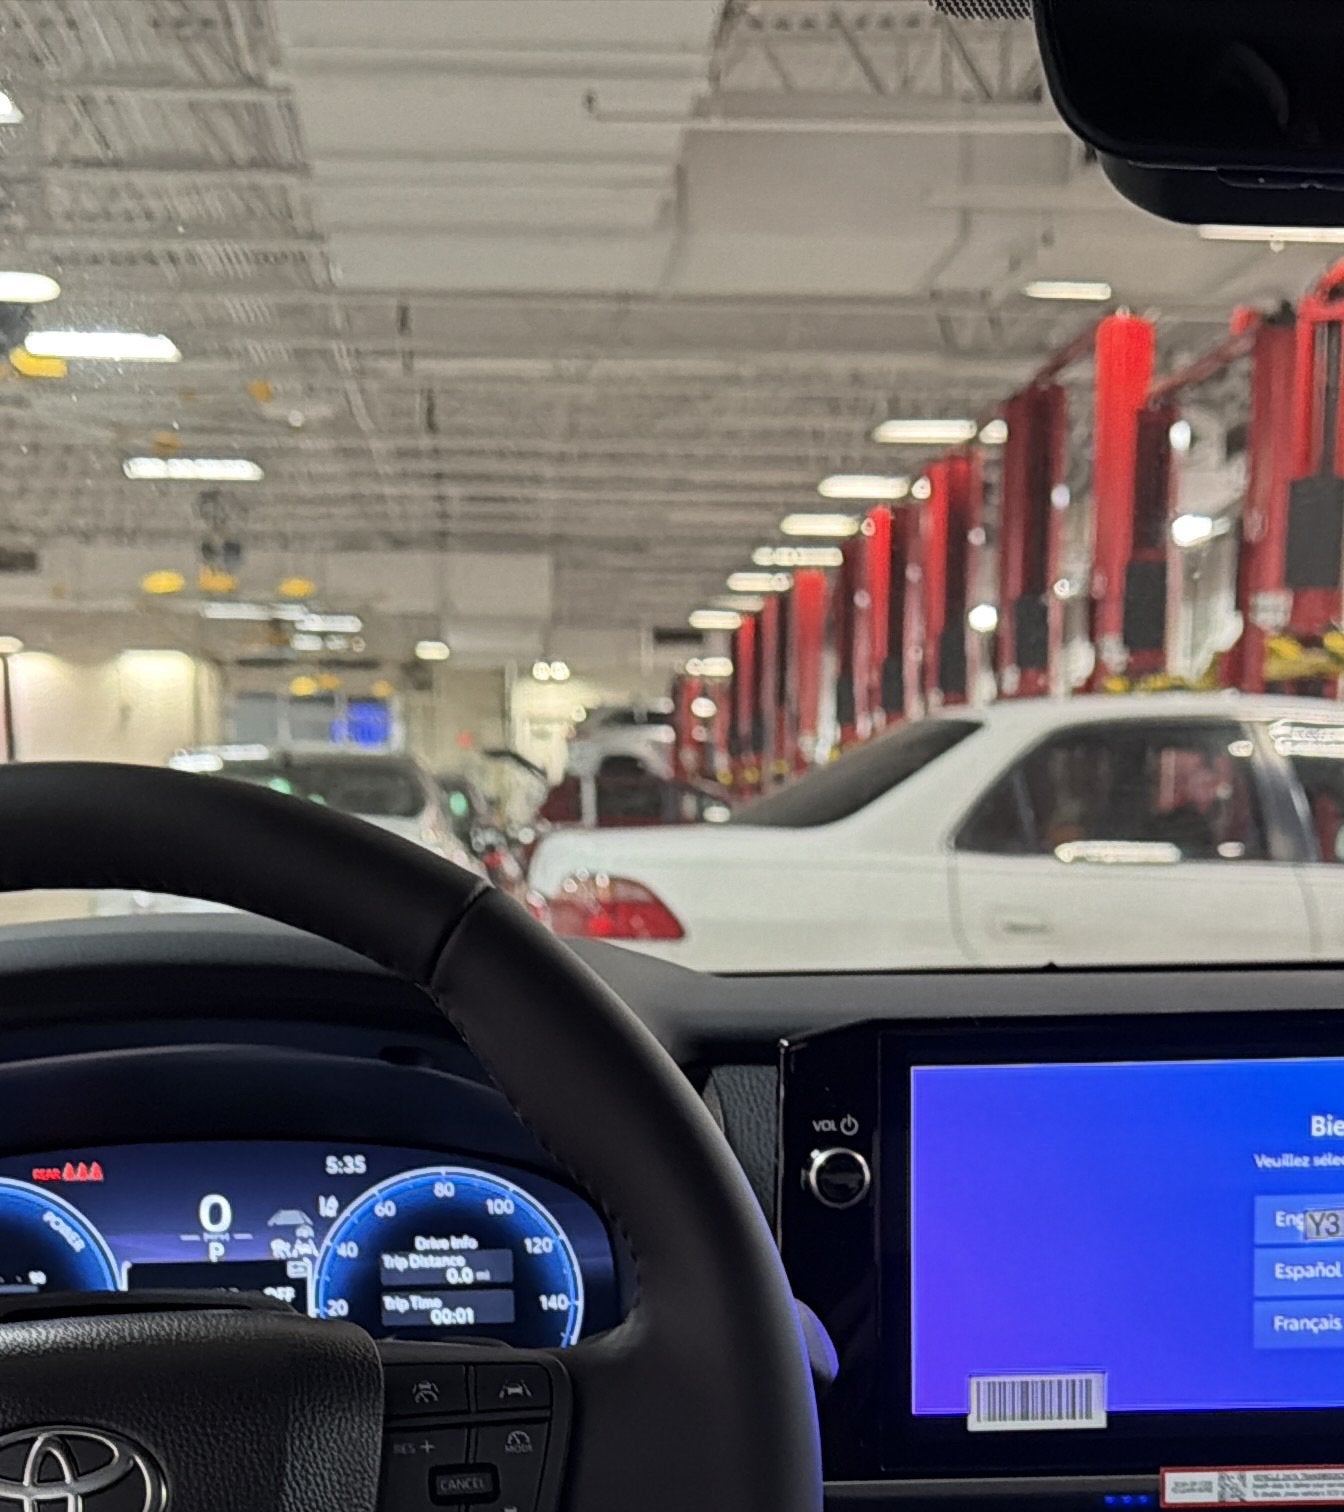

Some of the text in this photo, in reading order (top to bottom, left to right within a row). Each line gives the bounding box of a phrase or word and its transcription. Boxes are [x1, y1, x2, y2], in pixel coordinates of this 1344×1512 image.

[812, 1120, 838, 1132] VOL
[325, 1155, 367, 1175] 5:35
[1253, 1153, 1310, 1168] Veuillez
[433, 1182, 455, 1198] 80
[198, 1193, 233, 1233] 0
[374, 1200, 397, 1218] 60
[486, 1199, 515, 1216] 100
[1307, 1212, 1341, 1237] Y3
[337, 1241, 359, 1259] 40
[414, 1234, 479, 1250] Drive Info
[524, 1237, 554, 1254] 120
[208, 1241, 226, 1262] P
[382, 1252, 467, 1271] Trip Distance
[445, 1268, 491, 1284] 0.0 mi
[1274, 1261, 1343, 1281] Español
[327, 1299, 349, 1316] 20
[382, 1294, 443, 1313] Trip Time
[538, 1294, 569, 1311] 140
[430, 1307, 475, 1325] 00:01
[1273, 1314, 1343, 1334] Français
[439, 1477, 485, 1491] CANCEL
